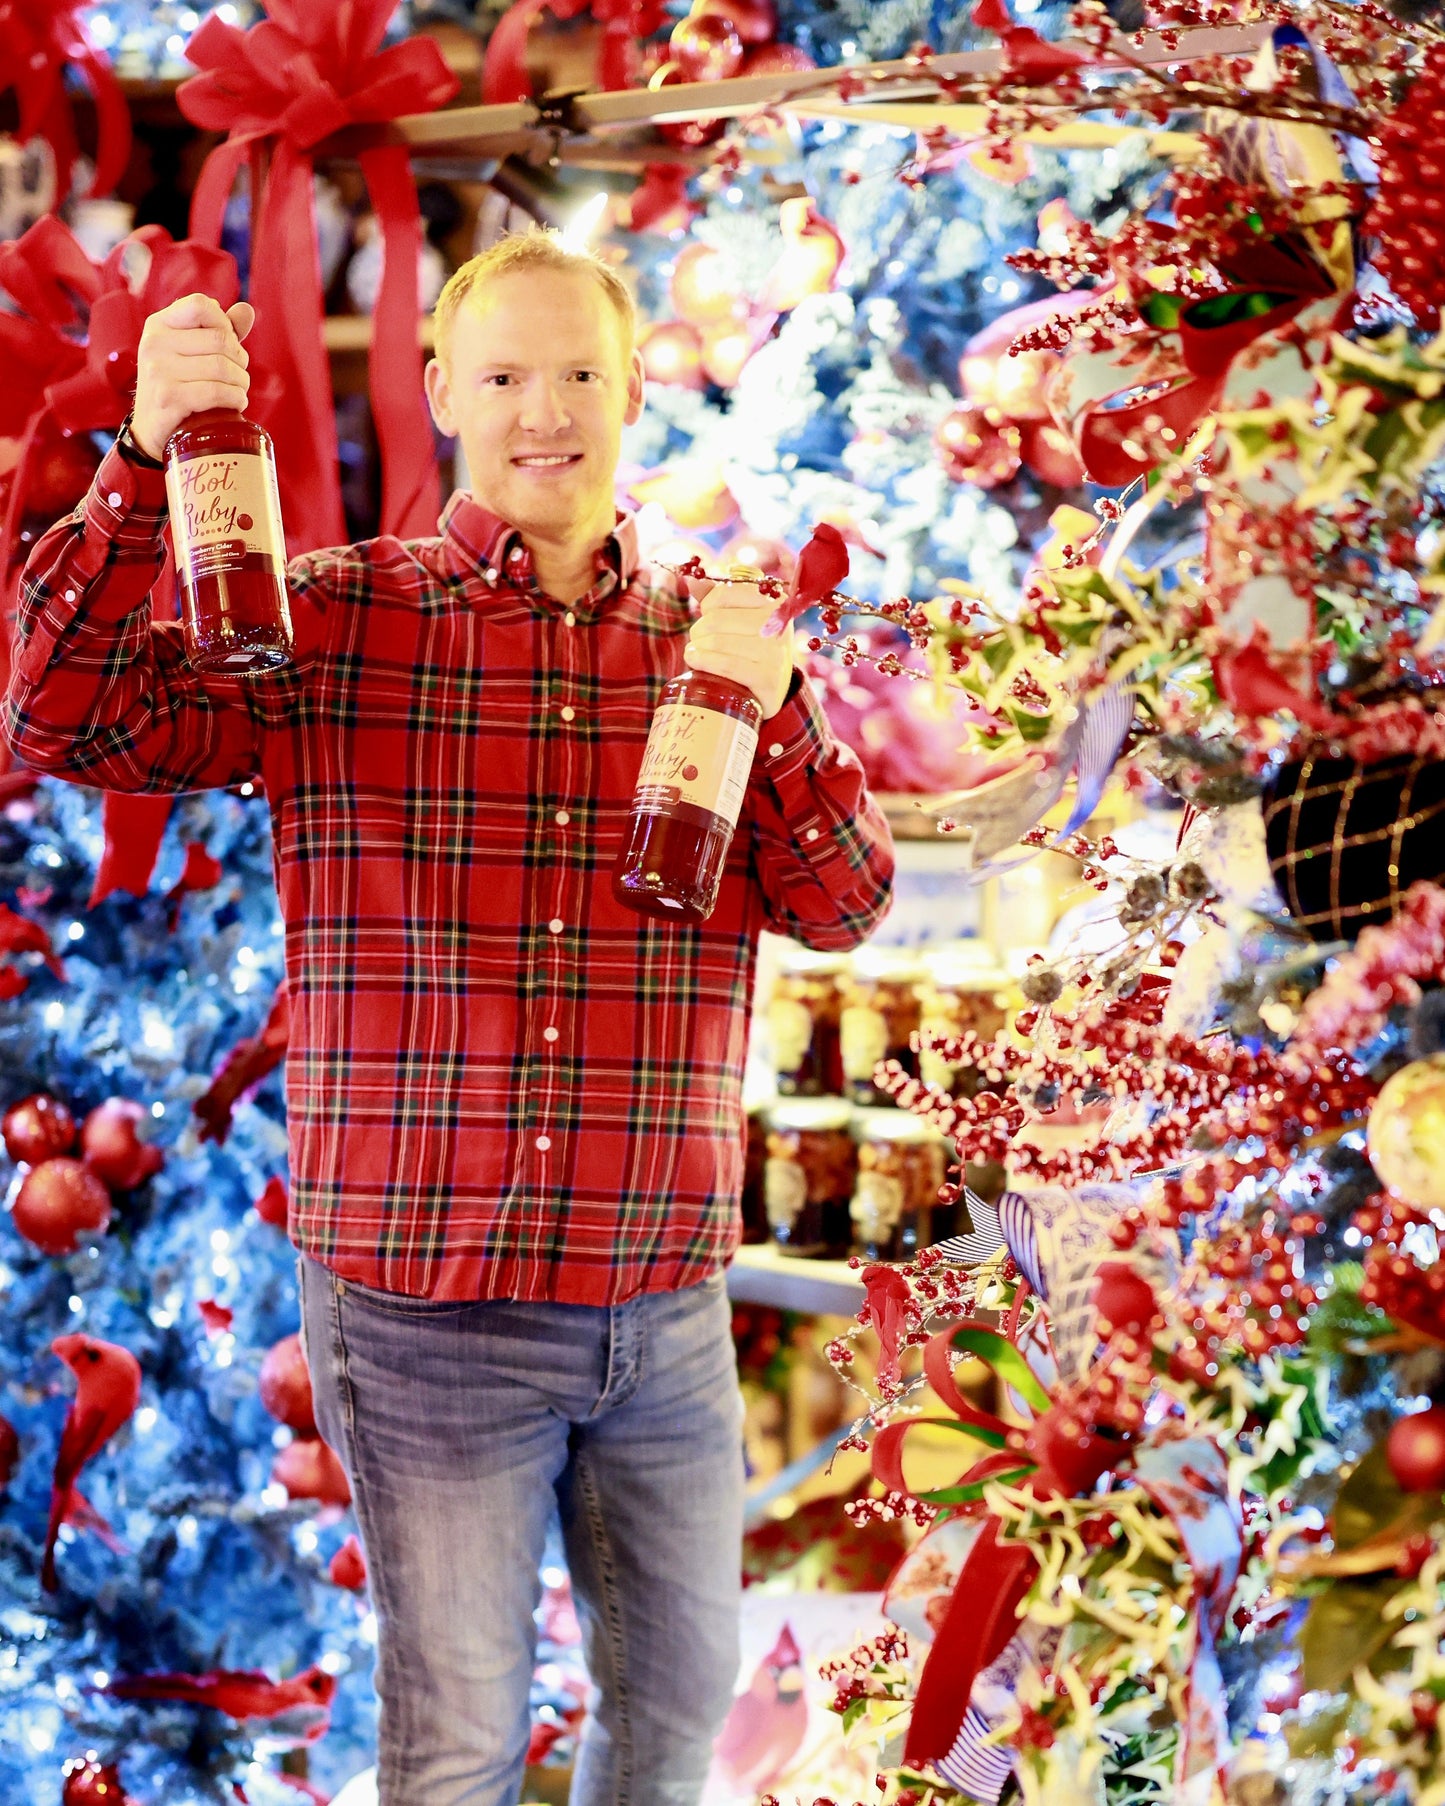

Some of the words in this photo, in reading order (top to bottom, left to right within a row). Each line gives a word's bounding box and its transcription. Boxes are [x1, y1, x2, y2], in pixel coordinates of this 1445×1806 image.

[181, 461, 233, 499] Hot
[184, 495, 237, 537] Ruby
[653, 709, 698, 739] Hot
[643, 742, 687, 780] Ruby
